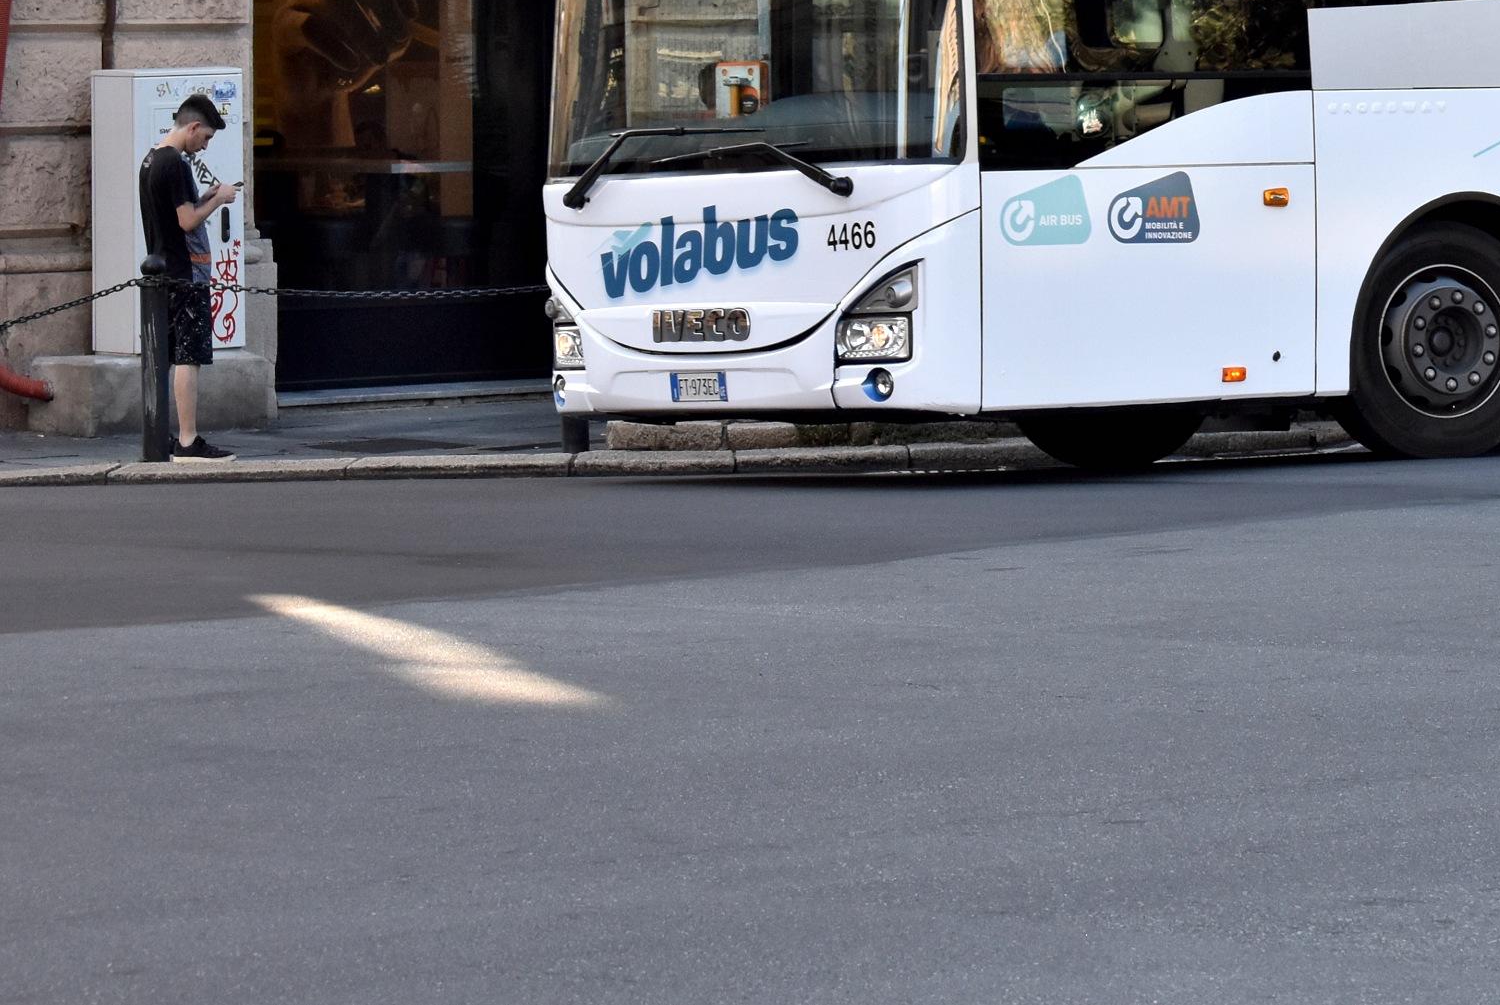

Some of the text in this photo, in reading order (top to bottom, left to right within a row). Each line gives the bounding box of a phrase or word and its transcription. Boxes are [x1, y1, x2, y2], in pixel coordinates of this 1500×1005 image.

[1039, 214, 1083, 226] AIR BUS
[1146, 197, 1190, 218] AMT
[827, 220, 876, 252] 4466
[1145, 231, 1193, 240] INNOVAZIONE
[600, 205, 800, 299] volabus
[652, 307, 751, 343] IVECO
